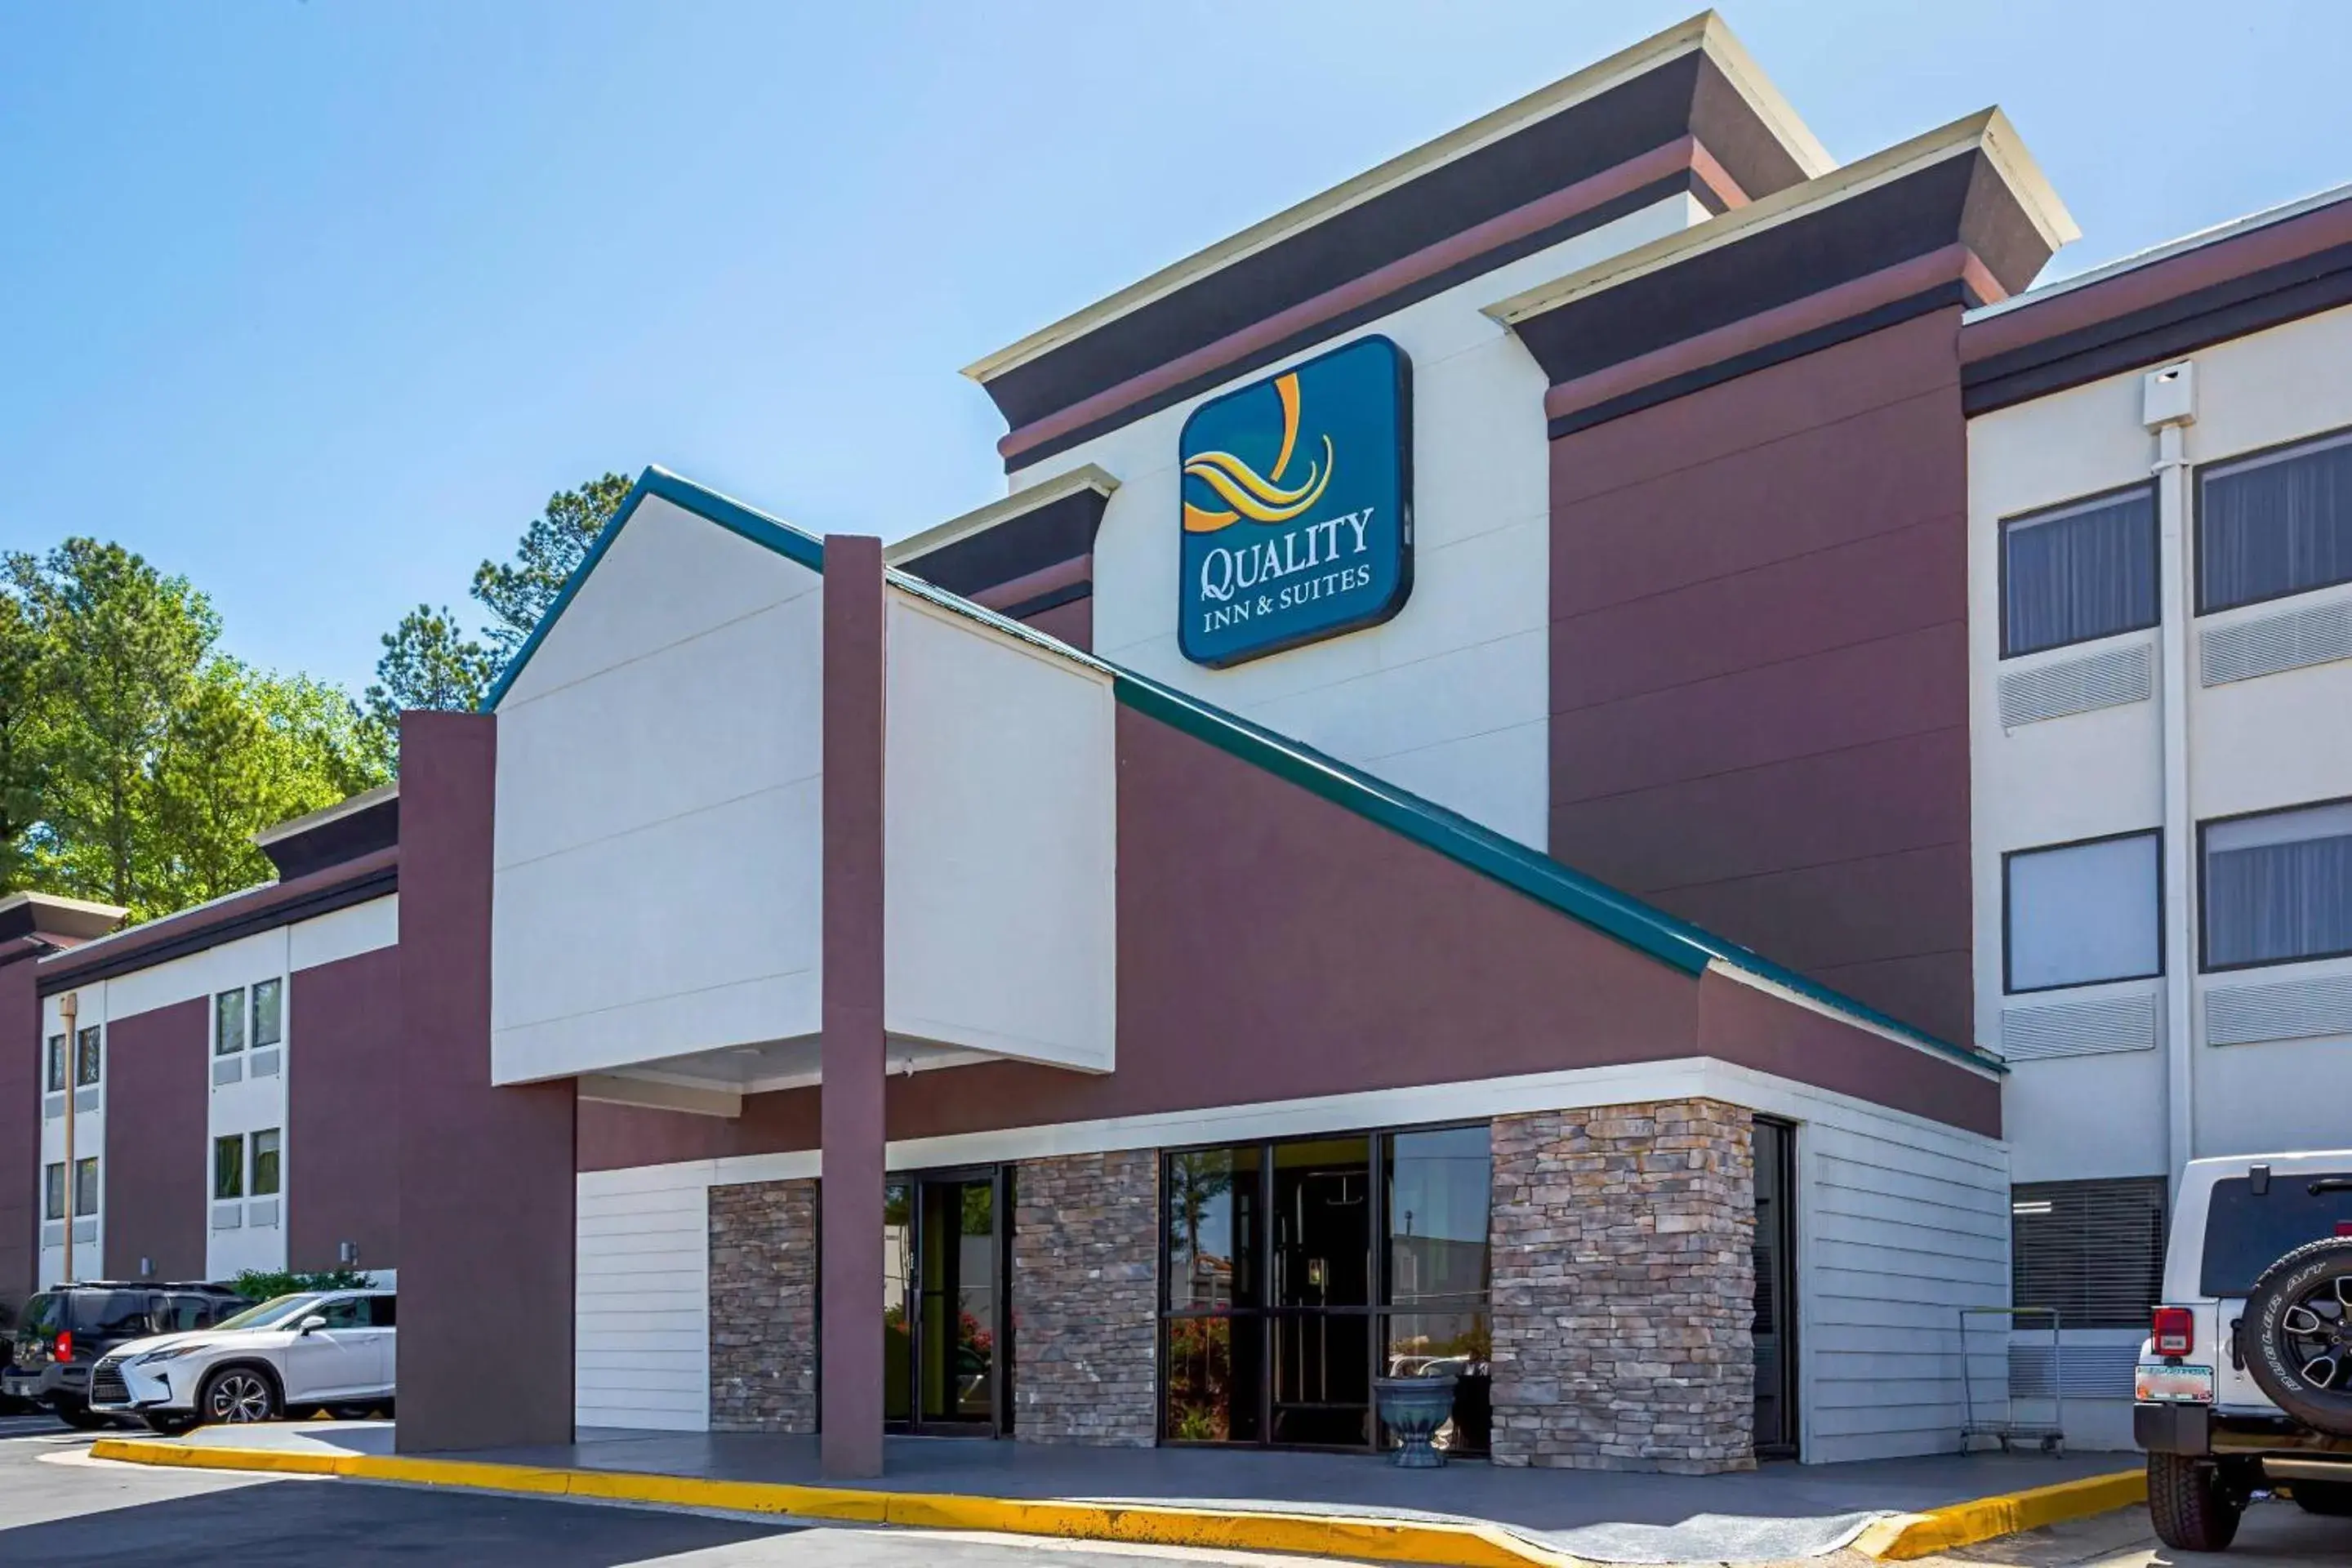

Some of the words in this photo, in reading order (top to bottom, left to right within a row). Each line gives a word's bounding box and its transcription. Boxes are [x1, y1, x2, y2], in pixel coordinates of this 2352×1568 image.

[1200, 507, 1374, 600] QUALITY
[1203, 599, 1250, 632] INN
[1256, 595, 1273, 616] &
[1280, 564, 1370, 609] SUITES
